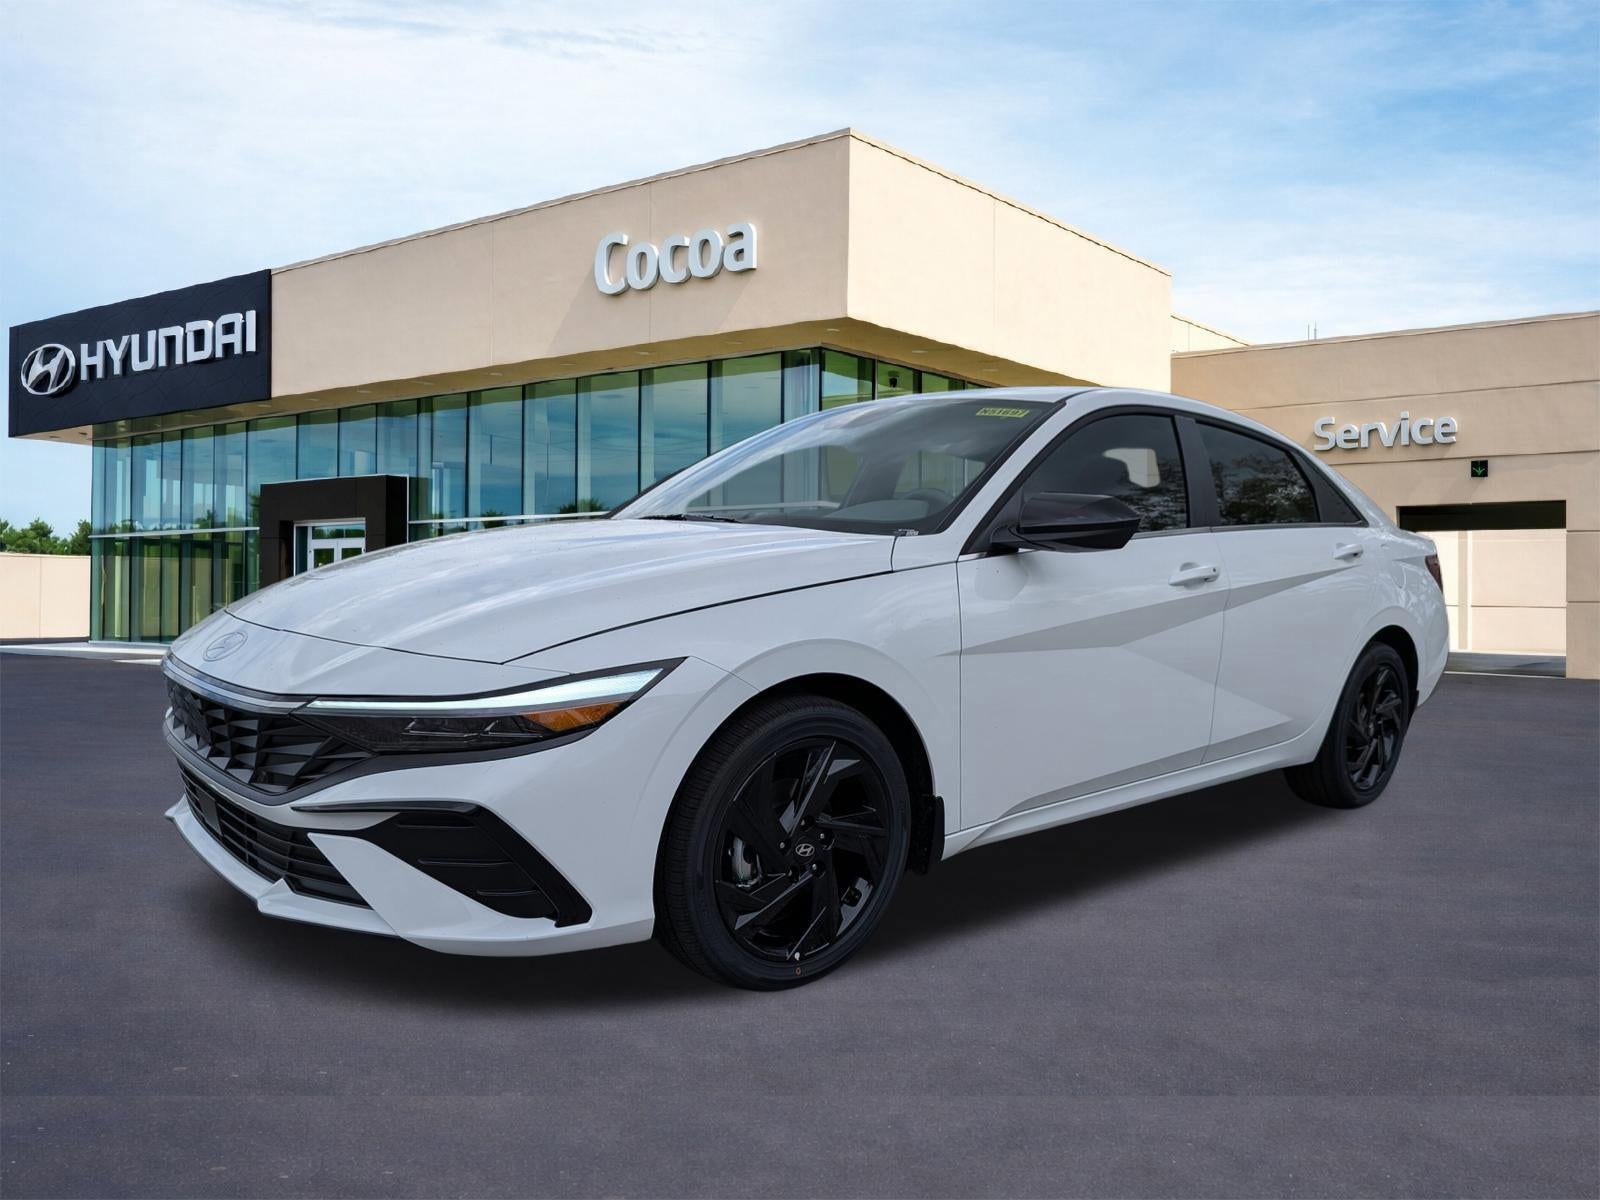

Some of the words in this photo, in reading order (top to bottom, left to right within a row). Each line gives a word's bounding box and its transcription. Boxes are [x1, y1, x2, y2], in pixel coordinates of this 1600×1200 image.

[594, 222, 757, 295] Cocoa
[79, 310, 257, 381] HYUNDAI
[1313, 411, 1458, 450] Service
